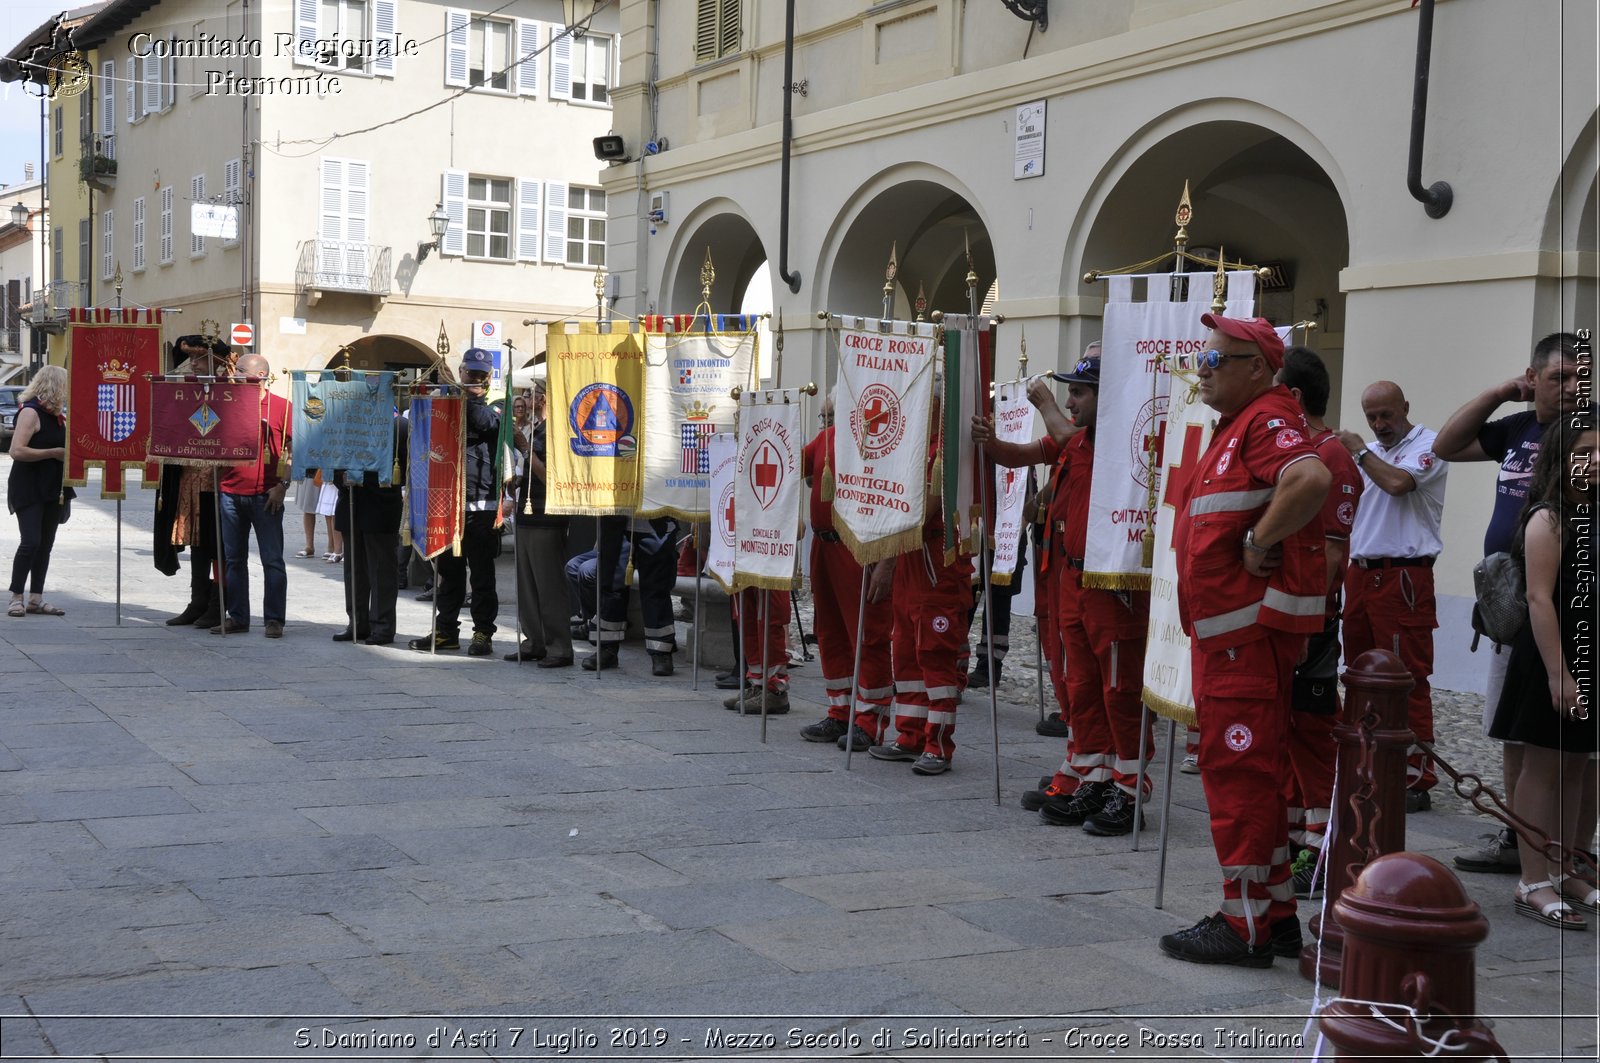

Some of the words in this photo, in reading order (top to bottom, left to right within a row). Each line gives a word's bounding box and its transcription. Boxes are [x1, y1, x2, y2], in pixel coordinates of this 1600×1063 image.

[845, 334, 883, 352] CROCE
[888, 339, 925, 355] ROSSA
[1136, 339, 1171, 354] CROCE
[558, 351, 595, 360] GRUPPO
[674, 359, 695, 368] CENTRO
[697, 359, 730, 368] INCONTRO
[856, 353, 909, 373] ITALIANA
[864, 450, 881, 460] DEL
[880, 415, 907, 458] SOCCORSO
[154, 444, 172, 453] SAN
[177, 446, 215, 455] DAMIANO
[232, 447, 253, 456] ASTI
[1524, 453, 1539, 472] S
[863, 466, 874, 475] DI
[555, 481, 575, 490] SAN
[576, 482, 618, 492] DAMIANO
[665, 479, 675, 488] SAN
[676, 479, 707, 488] DAMIANO
[838, 473, 905, 495] MONTIGLIO
[836, 487, 910, 513] MONFERRATO
[856, 506, 875, 516] ASTI
